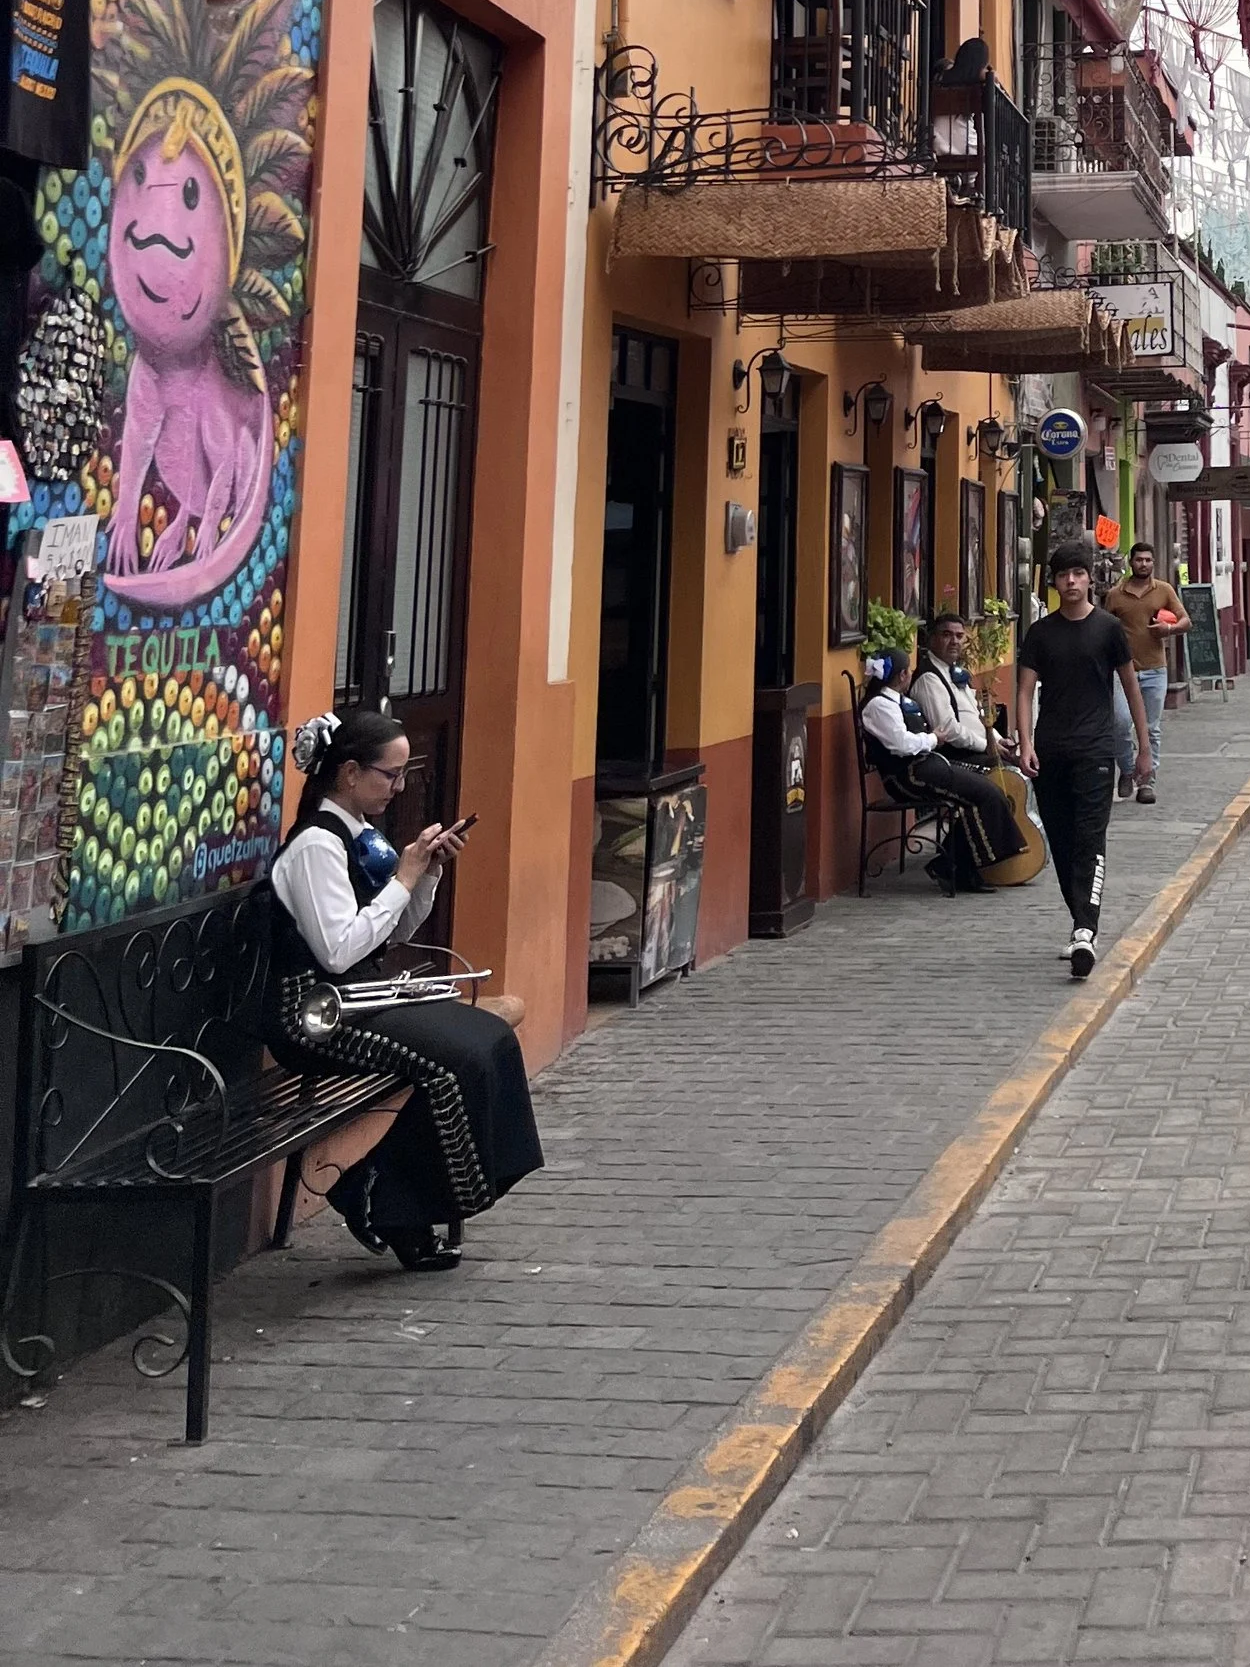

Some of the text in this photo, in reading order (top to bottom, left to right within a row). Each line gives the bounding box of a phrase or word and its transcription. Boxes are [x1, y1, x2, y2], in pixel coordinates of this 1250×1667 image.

[1041, 429, 1080, 441] Corona
[1168, 453, 1199, 463] Dental
[106, 628, 221, 678] TEQUILA
